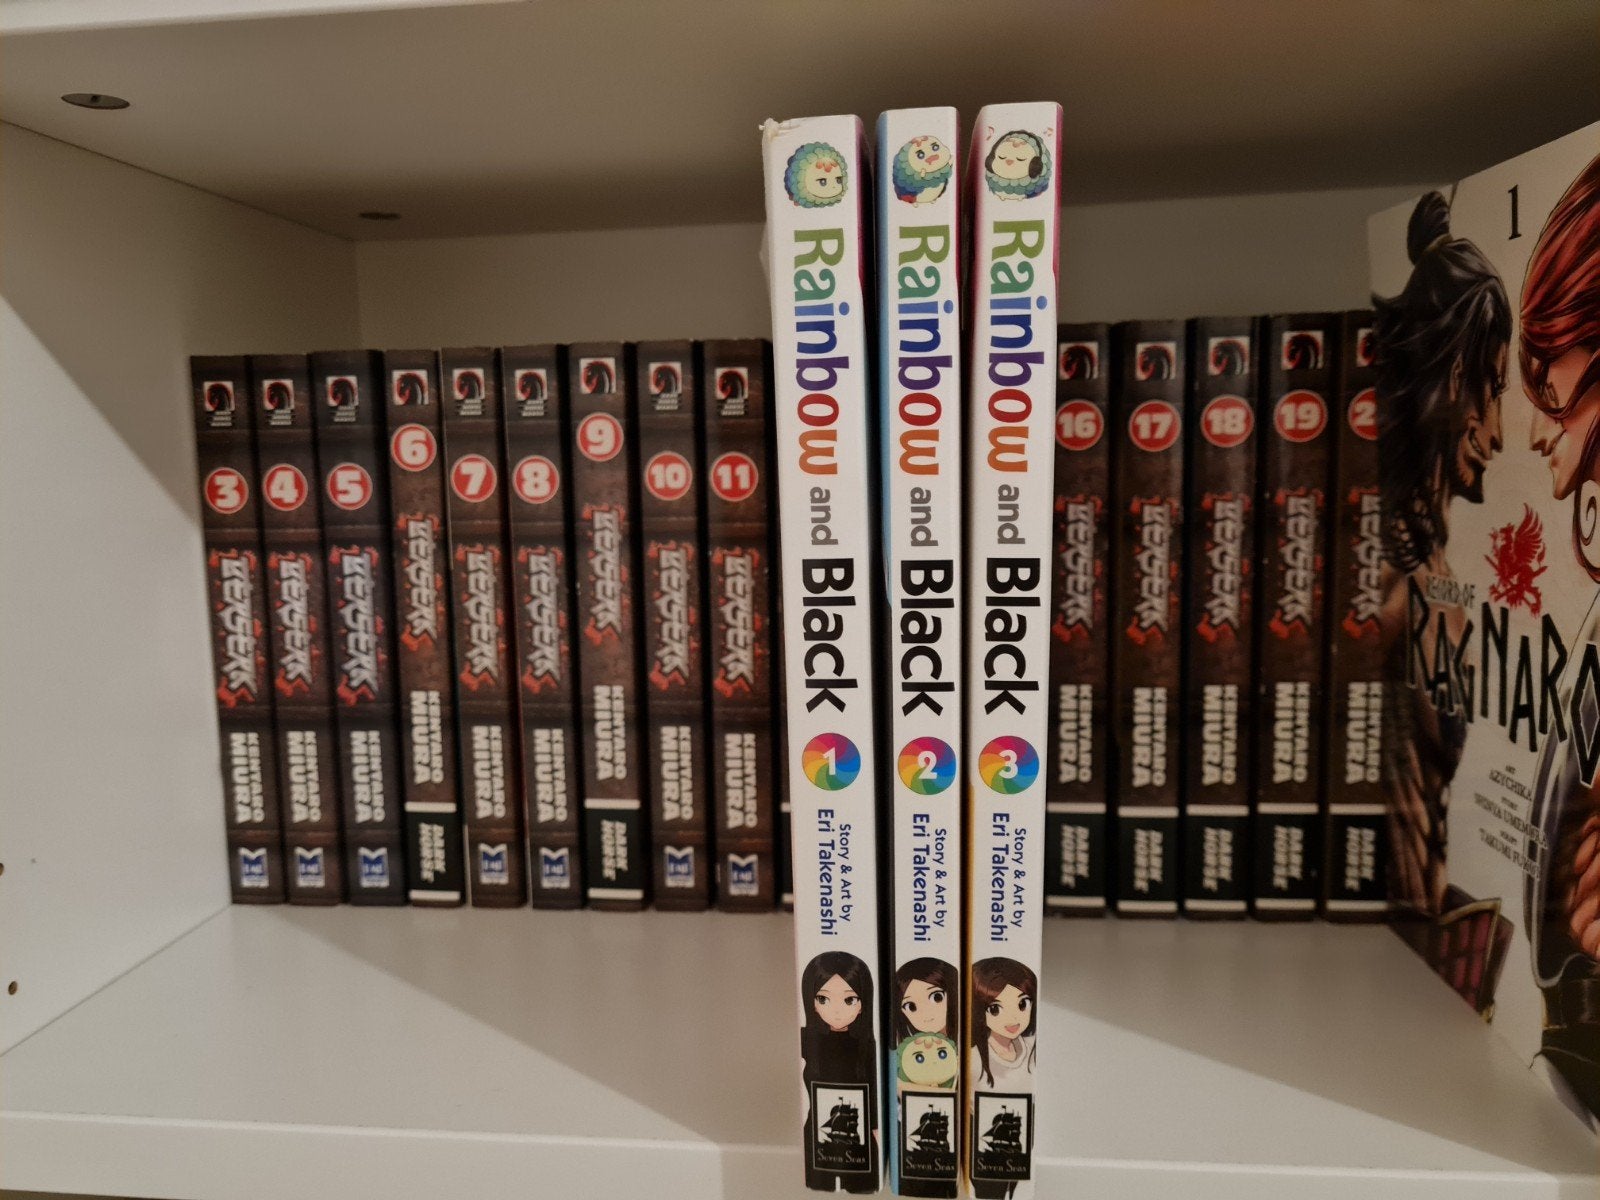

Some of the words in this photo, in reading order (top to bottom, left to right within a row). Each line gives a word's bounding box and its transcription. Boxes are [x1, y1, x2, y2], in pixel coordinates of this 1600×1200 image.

[1508, 184, 1522, 240] 1
[793, 228, 849, 475] Rainbow
[898, 225, 954, 475] Rainbow
[986, 220, 1047, 473] Rainbow
[1059, 412, 1096, 439] 16
[1134, 412, 1172, 439] 17
[1206, 408, 1246, 435] 18
[1281, 403, 1320, 430] 19
[1354, 403, 1376, 426] 2
[400, 430, 428, 465] 6
[586, 420, 615, 454] 9
[214, 475, 240, 508] 3
[270, 470, 298, 503] 4
[336, 470, 363, 504] 5
[461, 462, 486, 495] 7
[522, 462, 551, 497] 8
[652, 464, 686, 490] 10
[717, 464, 750, 490] 11
[809, 486, 838, 545] and
[910, 487, 939, 547] and
[997, 484, 1025, 544] and
[802, 558, 858, 713] Black
[901, 560, 955, 716] Black
[984, 558, 1040, 715] Black
[410, 690, 430, 784] MIURA
[593, 685, 613, 781] MIURA
[1059, 684, 1078, 784] MIURA
[1133, 687, 1152, 788] MIURA
[1203, 684, 1222, 786] MIURA
[1273, 682, 1294, 783] MIURA
[1346, 682, 1367, 784] MIURA
[230, 732, 250, 824] MIURA
[287, 731, 306, 823] MIURA
[350, 731, 372, 824] MIURA
[472, 726, 494, 819] MIURA
[534, 728, 554, 823] MIURA
[660, 726, 680, 822] MIURA
[823, 747, 836, 775] 1
[917, 751, 938, 779] 2
[999, 750, 1018, 779] 3
[724, 733, 744, 829] MIURA
[818, 809, 834, 833] Eri
[913, 813, 930, 837] Eri
[992, 813, 1010, 837] Eri
[839, 824, 851, 861] Story
[934, 828, 947, 865] Story
[1011, 828, 1026, 865] Story
[841, 864, 852, 874] &
[935, 869, 947, 879] &
[1014, 869, 1026, 879] &
[819, 840, 837, 936] Takenashi
[841, 879, 852, 900] Art
[913, 845, 931, 942] Takenashi
[935, 884, 947, 905] Art
[990, 845, 1009, 942] Takenashi
[1013, 884, 1025, 906] Art
[840, 905, 853, 922] by
[933, 910, 947, 928] by
[1011, 910, 1025, 928] by
